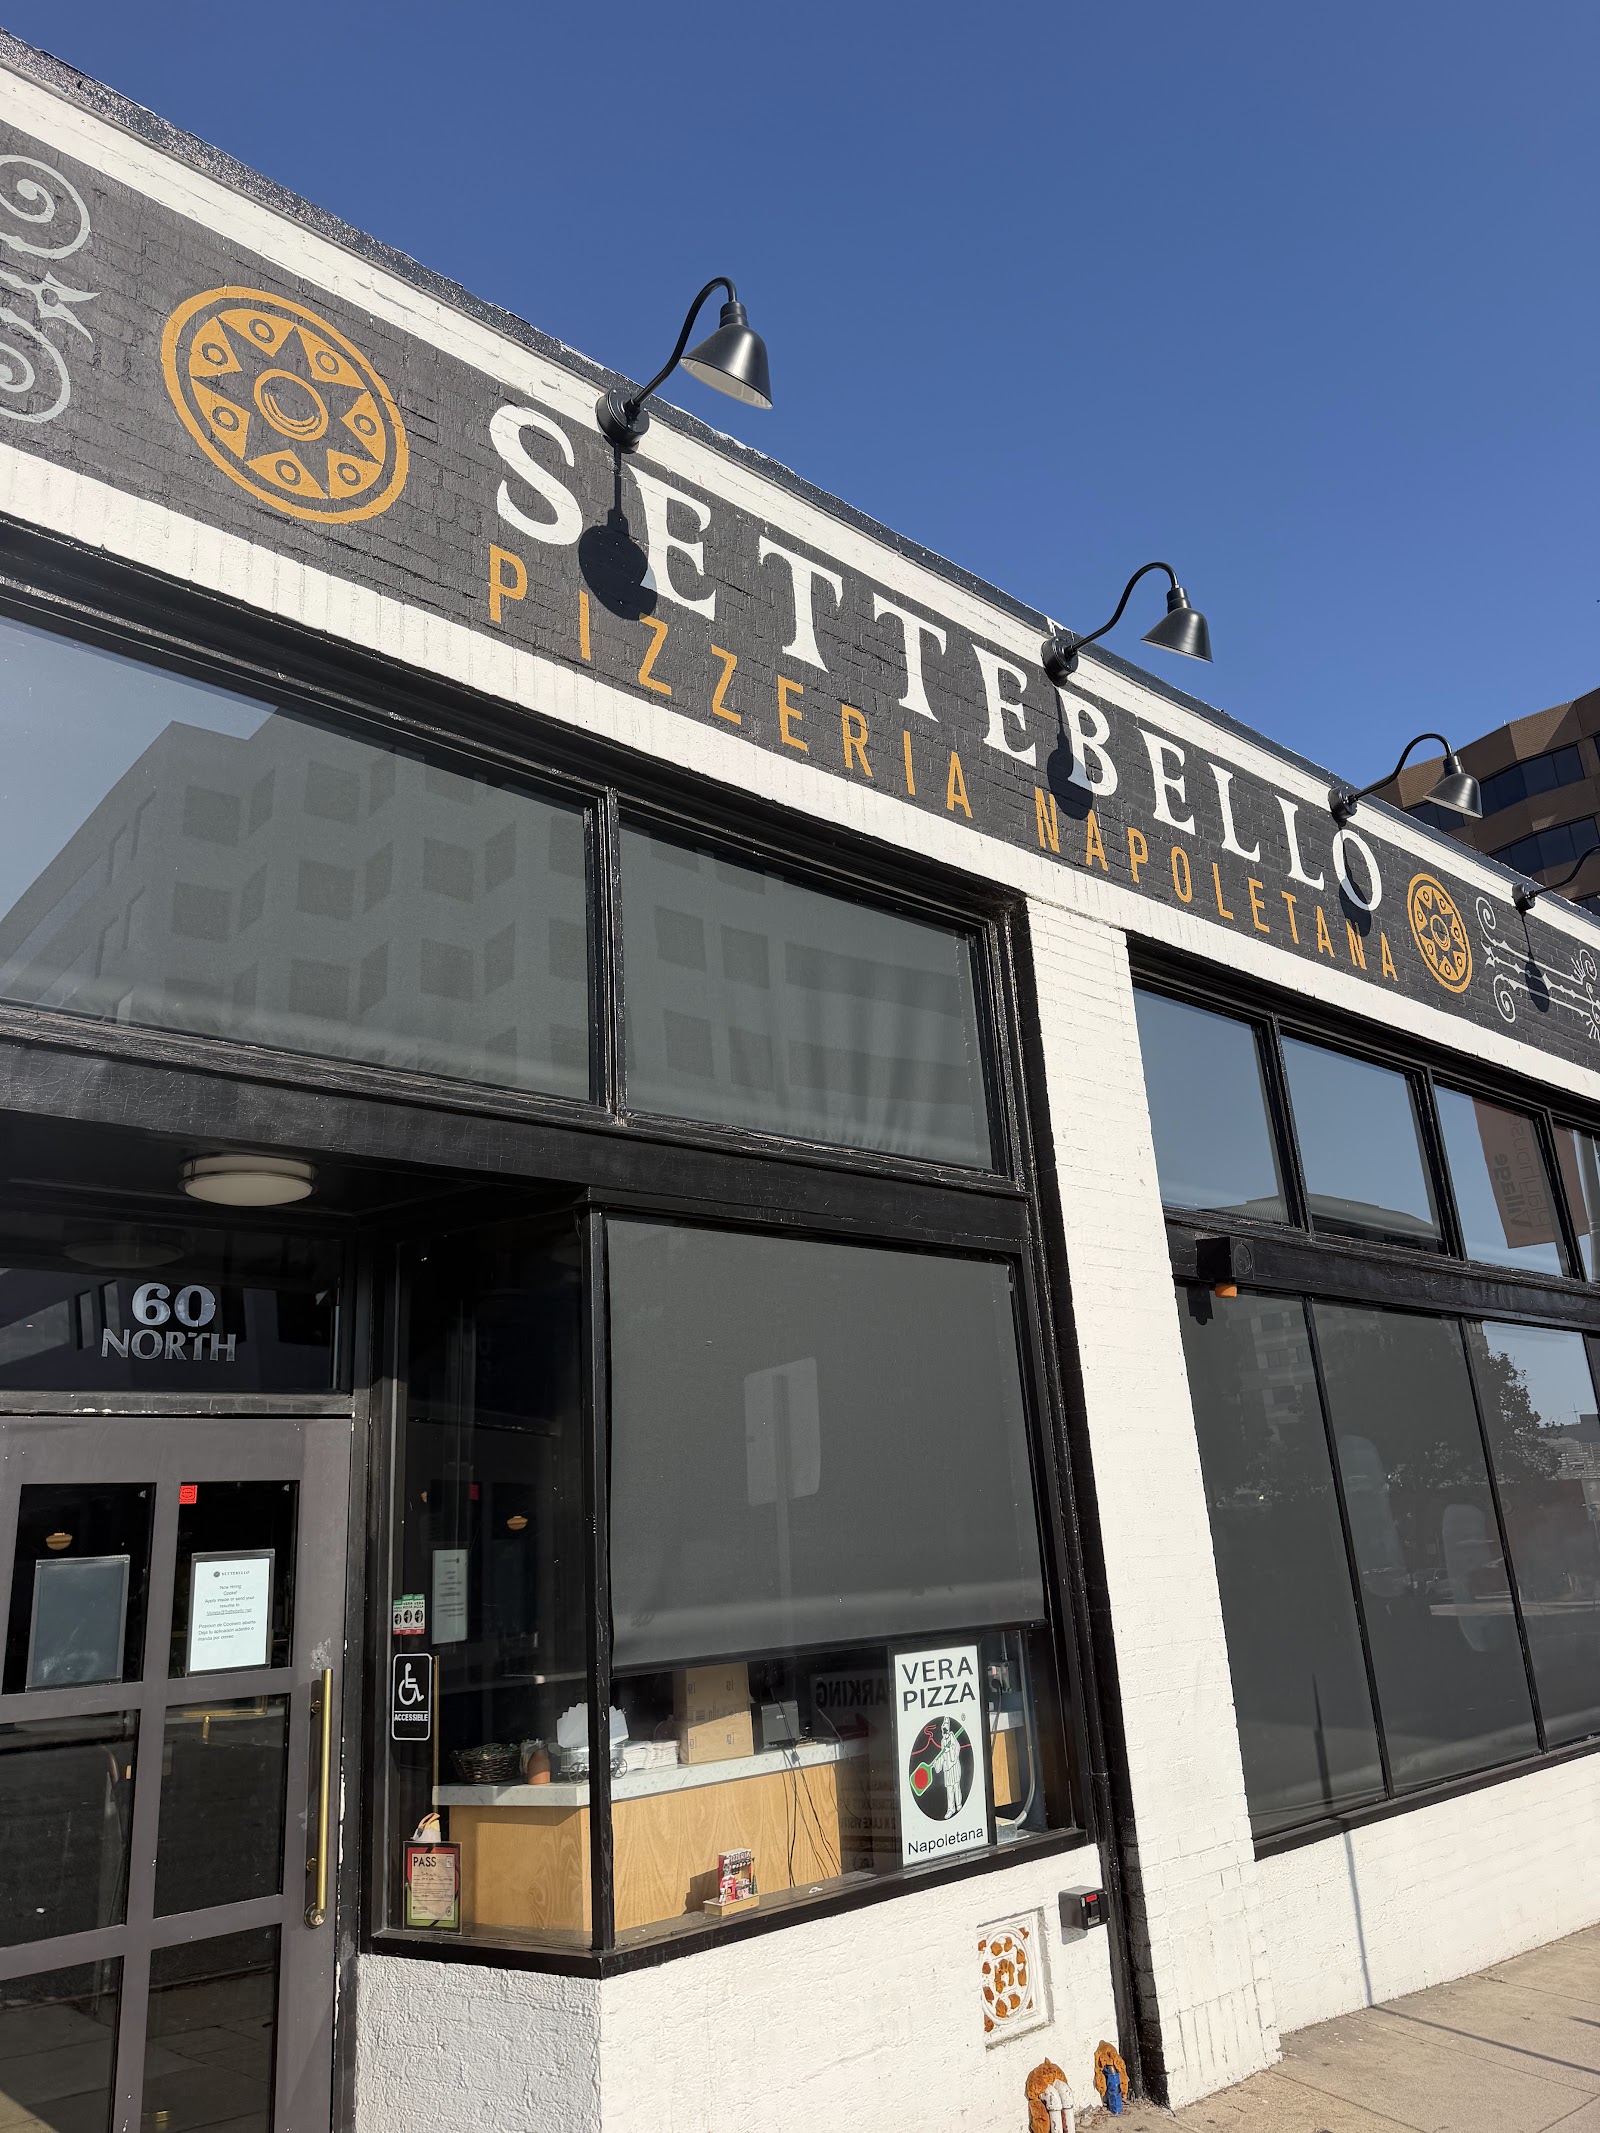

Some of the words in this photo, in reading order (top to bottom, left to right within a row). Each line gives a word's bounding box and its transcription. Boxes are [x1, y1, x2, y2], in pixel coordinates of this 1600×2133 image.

[488, 404, 1382, 912] SETTEBELLO
[489, 543, 974, 819] PIZZERIA
[1035, 785, 1398, 982] NAPOLETANA
[131, 1282, 217, 1328] 60
[101, 1328, 237, 1363] NORTH
[902, 1656, 974, 1685] VERA
[902, 1682, 976, 1712] PIZZA
[394, 1711, 429, 1723] ACCESSIBLE
[907, 1826, 984, 1858] Napoletana
[413, 1856, 437, 1868] PASS
